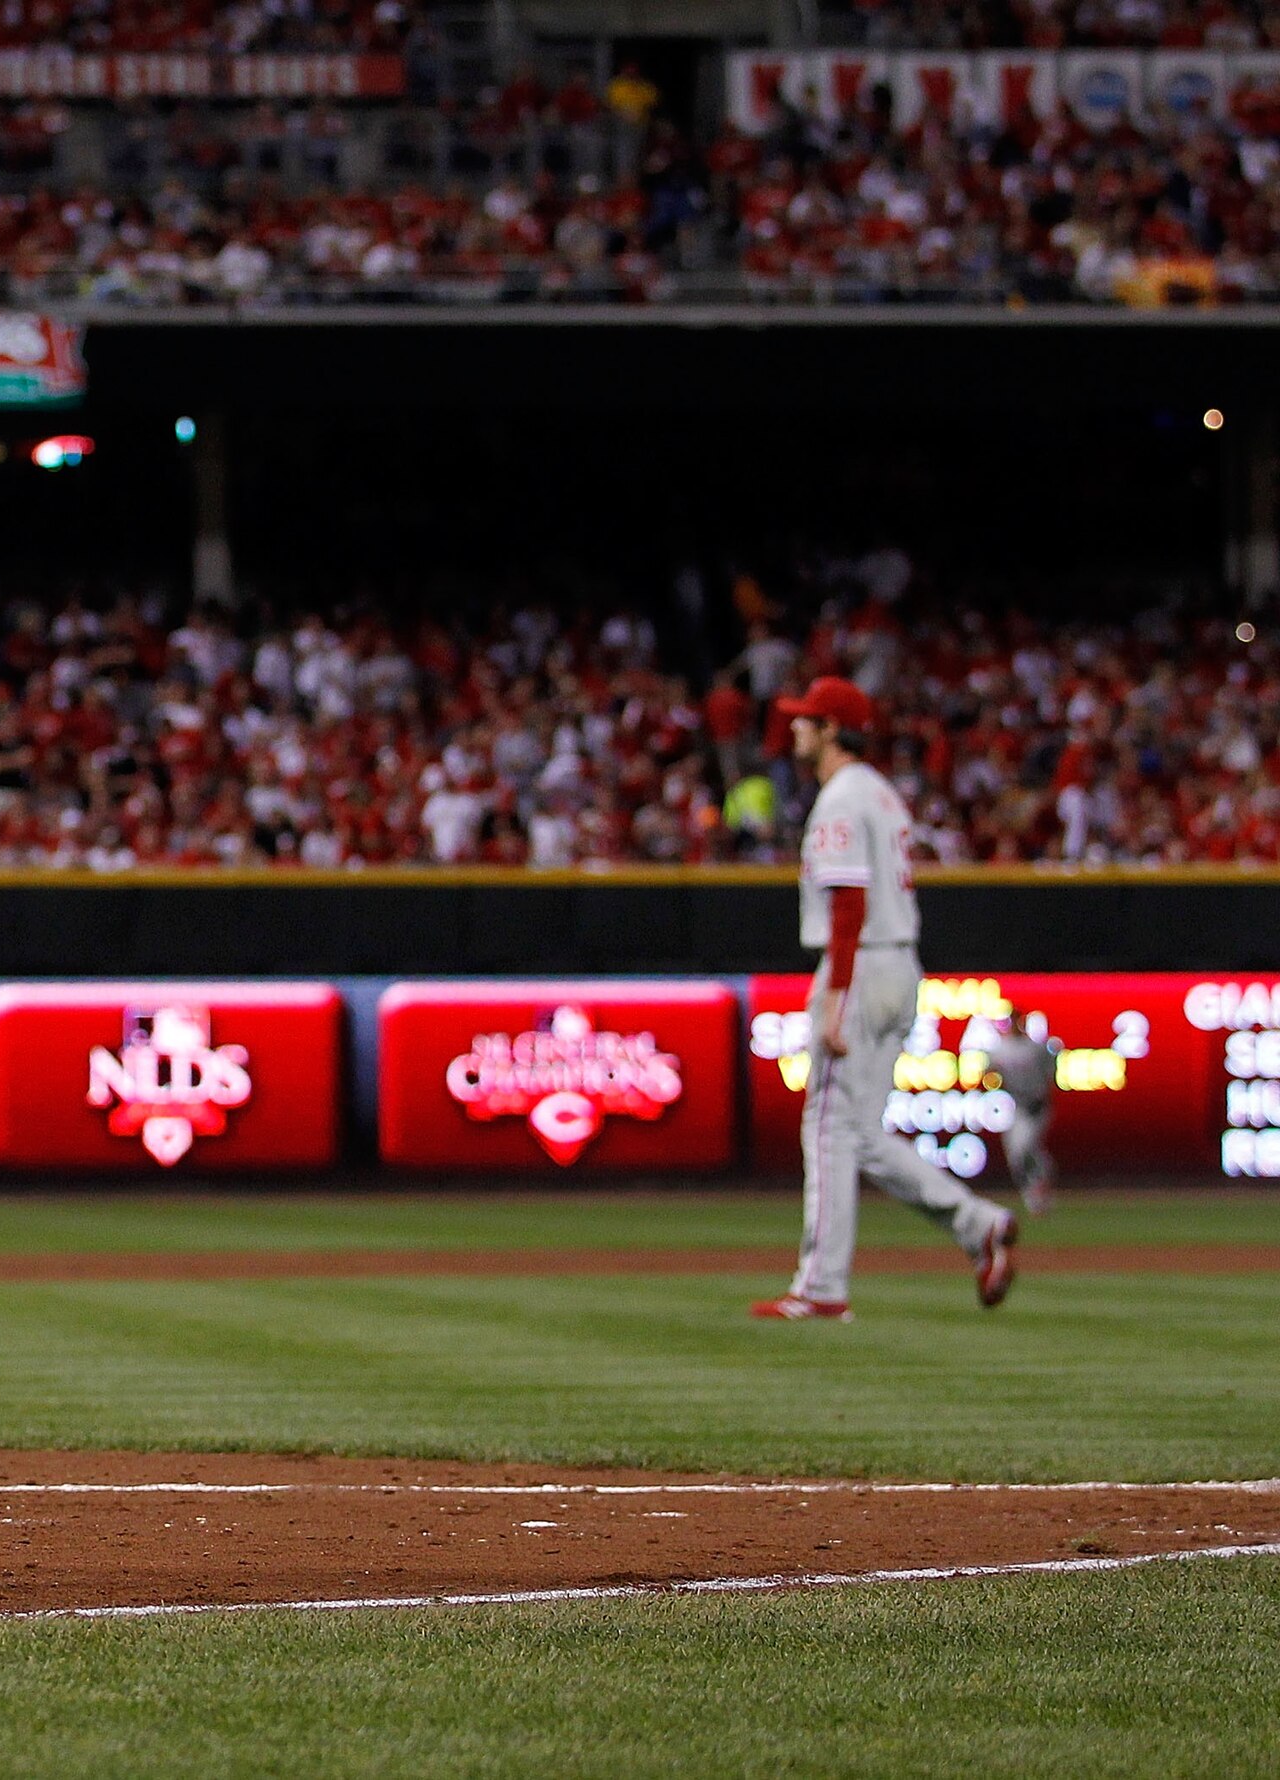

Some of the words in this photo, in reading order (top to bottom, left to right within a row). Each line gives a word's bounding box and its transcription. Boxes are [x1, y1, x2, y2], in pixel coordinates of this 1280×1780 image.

[1111, 1010, 1149, 1058] 2
[86, 1043, 252, 1108] NLDS
[446, 1052, 682, 1103] CHAMPIONS
